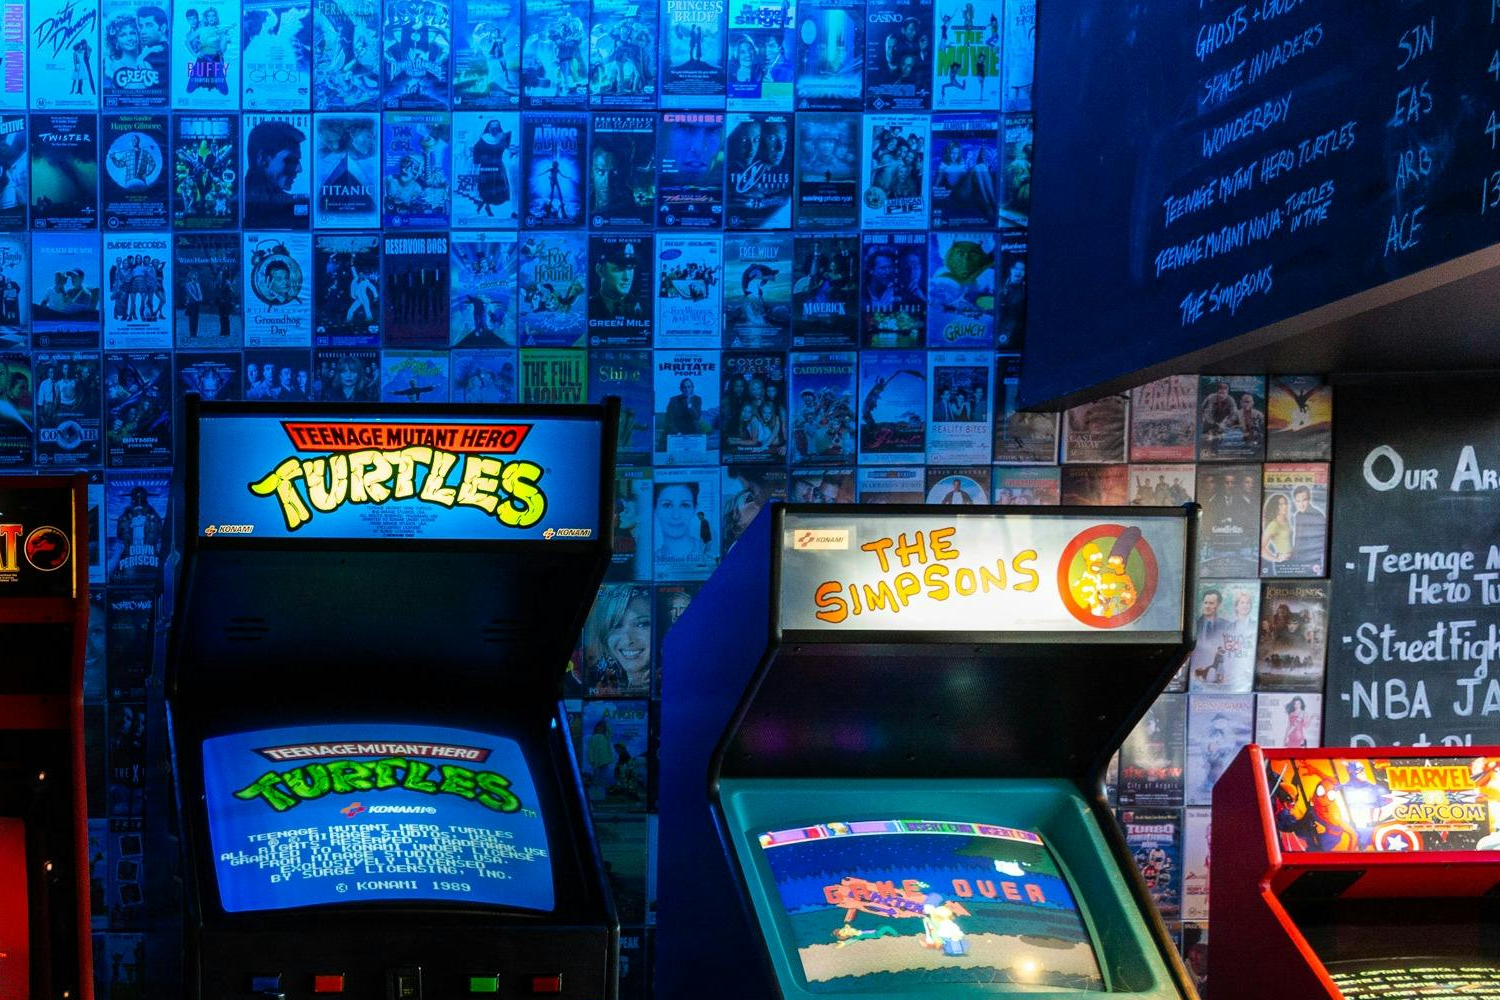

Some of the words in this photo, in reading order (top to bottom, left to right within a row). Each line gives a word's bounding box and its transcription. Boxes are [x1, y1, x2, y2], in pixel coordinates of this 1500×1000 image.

[667, 0, 724, 14] PRINCESS
[674, 11, 716, 23] BRIDE
[869, 14, 903, 23] CASINO
[1196, 6, 1248, 62] GHOSTS
[1203, 60, 1246, 104] SPACE
[1249, 23, 1322, 84] INVADERS
[1394, 80, 1433, 127] EAS
[1203, 91, 1292, 158] WONDERBOY
[39, 133, 91, 143] TWISTER
[1162, 179, 1218, 229] TEENAGE
[1219, 161, 1258, 204] MUTANT
[1261, 148, 1295, 185] HERO
[1298, 121, 1357, 167] TURTLES
[321, 185, 374, 196] TITANIC
[1285, 179, 1335, 216] TURTLES
[1291, 214, 1301, 233] IN
[1303, 200, 1332, 228] TIME
[1384, 205, 1425, 257] ACE
[385, 239, 425, 255] RESERVOIR
[426, 239, 447, 254] DOGS
[739, 245, 758, 258] FREE
[760, 245, 779, 259] WILLY
[1155, 234, 1204, 278] TEENAGE
[1205, 221, 1247, 259] MUTANT
[803, 301, 847, 316] MAVERICK
[1179, 289, 1209, 328] THE
[254, 315, 301, 326] Groundhog
[589, 318, 622, 327] GREEN
[624, 318, 651, 327] MILE
[270, 325, 288, 336] Day
[659, 362, 716, 372] IRRITATE
[728, 358, 781, 368] COYOTE
[792, 365, 855, 375] CADDYSHACK
[523, 361, 550, 386] THE
[553, 361, 582, 386] FULL
[297, 428, 385, 446] TEENAGE
[386, 429, 458, 446] MUTANT
[460, 430, 518, 449] HERO
[249, 446, 547, 531] TURTLES
[219, 525, 252, 534] KONAMI
[557, 529, 591, 537] KONAMI
[815, 536, 845, 544] KONAMI
[861, 526, 959, 573] THE
[129, 544, 154, 556] DOWN
[814, 549, 1040, 624] SIMPSONS
[1409, 573, 1471, 605] Hero
[264, 744, 359, 759] TEENAGE
[359, 743, 431, 756] MUTANT
[432, 746, 479, 759] HERO
[233, 757, 523, 813] TURTLES
[1386, 766, 1477, 790] MARVEL
[1394, 804, 1485, 821] CAPCOM
[248, 827, 318, 842] TEENAGE
[329, 823, 389, 833] MUTANT
[399, 824, 439, 832] HERO
[449, 825, 513, 839] TURTLES
[309, 831, 371, 842] MIRAGE
[381, 829, 457, 839] STUDIOS,
[469, 833, 503, 844] USA.
[221, 851, 246, 861] ALL
[259, 841, 320, 853] RIGHTS
[330, 836, 418, 847] RESERVED.
[433, 837, 516, 852] TRADEMARK
[524, 846, 547, 857] USE
[230, 850, 300, 866] GRANTED
[312, 847, 331, 855] TO
[342, 843, 400, 853] KONAMI
[413, 843, 463, 853] UNDER
[472, 846, 535, 861] LICENSE
[259, 857, 301, 869] FROM
[311, 851, 374, 862] MIRAGE
[385, 850, 461, 860] STUDIOS,
[474, 853, 508, 864] USA.
[281, 857, 395, 874] EXCLUSIVELY
[405, 857, 486, 869] LICENSED
[270, 872, 292, 883] BY
[303, 866, 355, 878] SURGE
[366, 864, 464, 875] LICENSING,
[478, 868, 512, 879] INC.
[356, 880, 418, 891] KONAMI
[432, 881, 471, 892] 1989
[952, 879, 1046, 903] OVER
